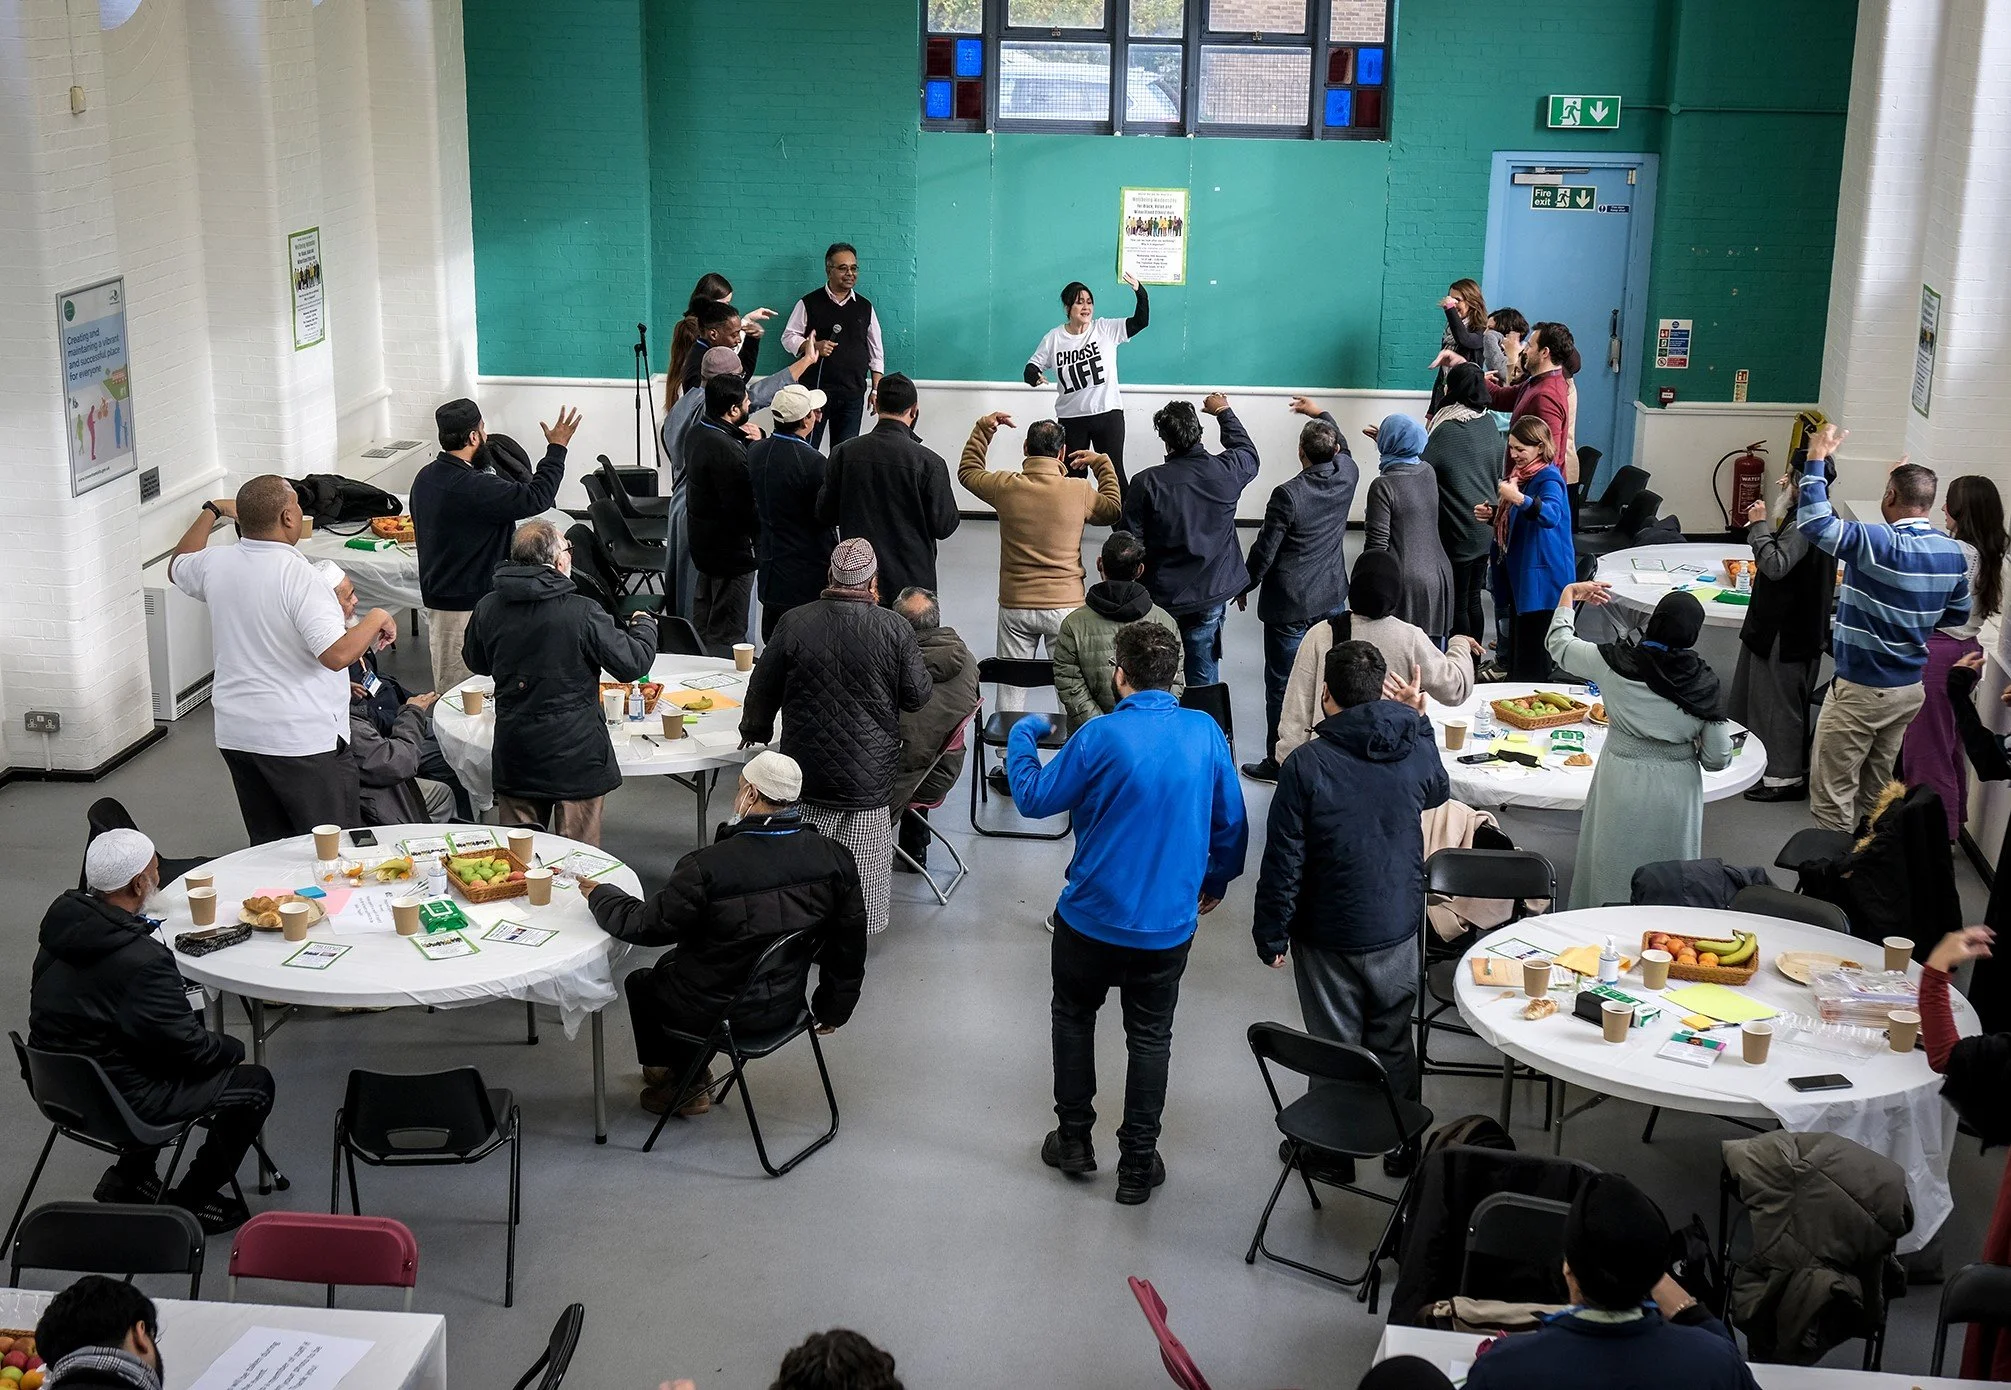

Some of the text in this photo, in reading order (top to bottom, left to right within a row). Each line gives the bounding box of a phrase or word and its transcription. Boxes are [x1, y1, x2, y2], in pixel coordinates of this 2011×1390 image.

[1534, 197, 1551, 206] exit
[1535, 188, 1551, 197] Fire
[67, 328, 100, 345] Creating and
[67, 341, 98, 357] maintaining
[102, 333, 120, 346] vibrant
[68, 345, 121, 370] and successful place
[1056, 341, 1100, 367] CHOOSE
[69, 365, 102, 381] for everyone
[1058, 355, 1105, 394] LIFE
